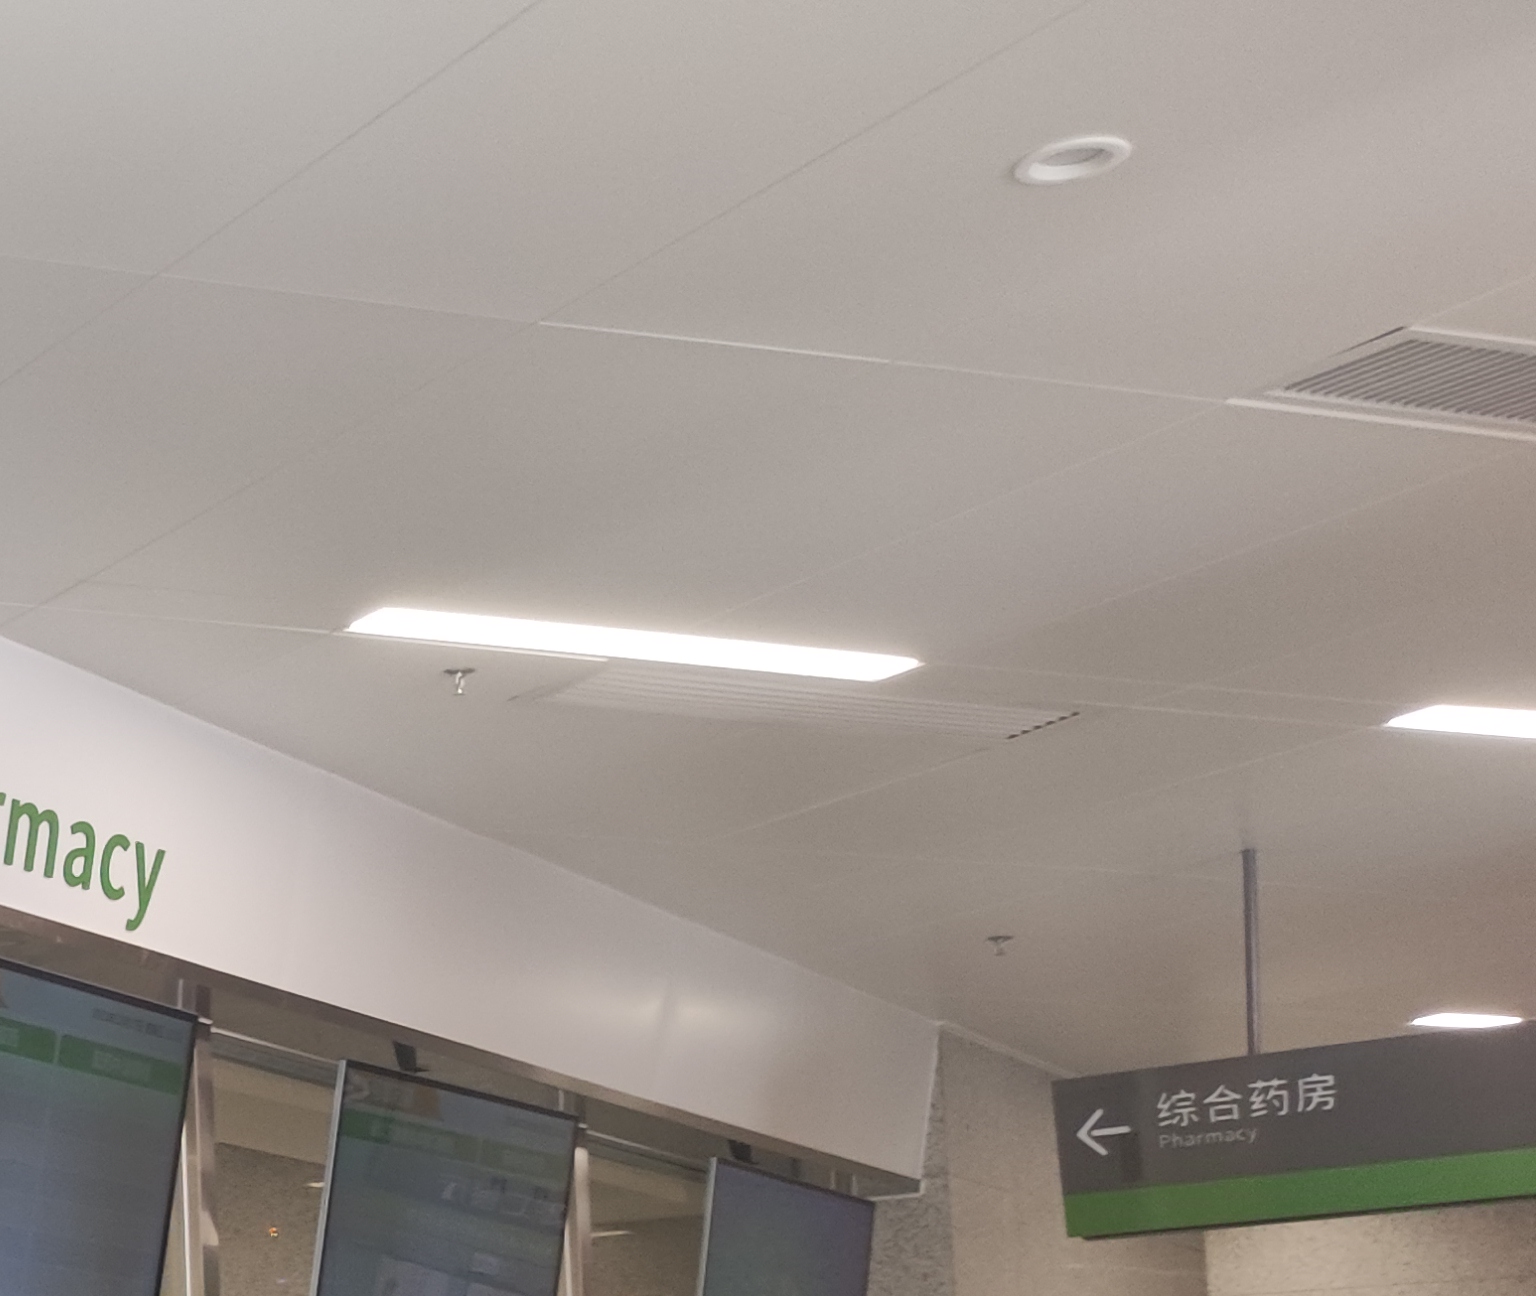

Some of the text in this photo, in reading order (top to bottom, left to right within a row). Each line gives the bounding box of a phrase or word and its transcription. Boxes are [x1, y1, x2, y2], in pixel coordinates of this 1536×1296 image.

[1156, 1073, 1338, 1128] 综合药房
[1158, 1126, 1259, 1150] Pharmacy
